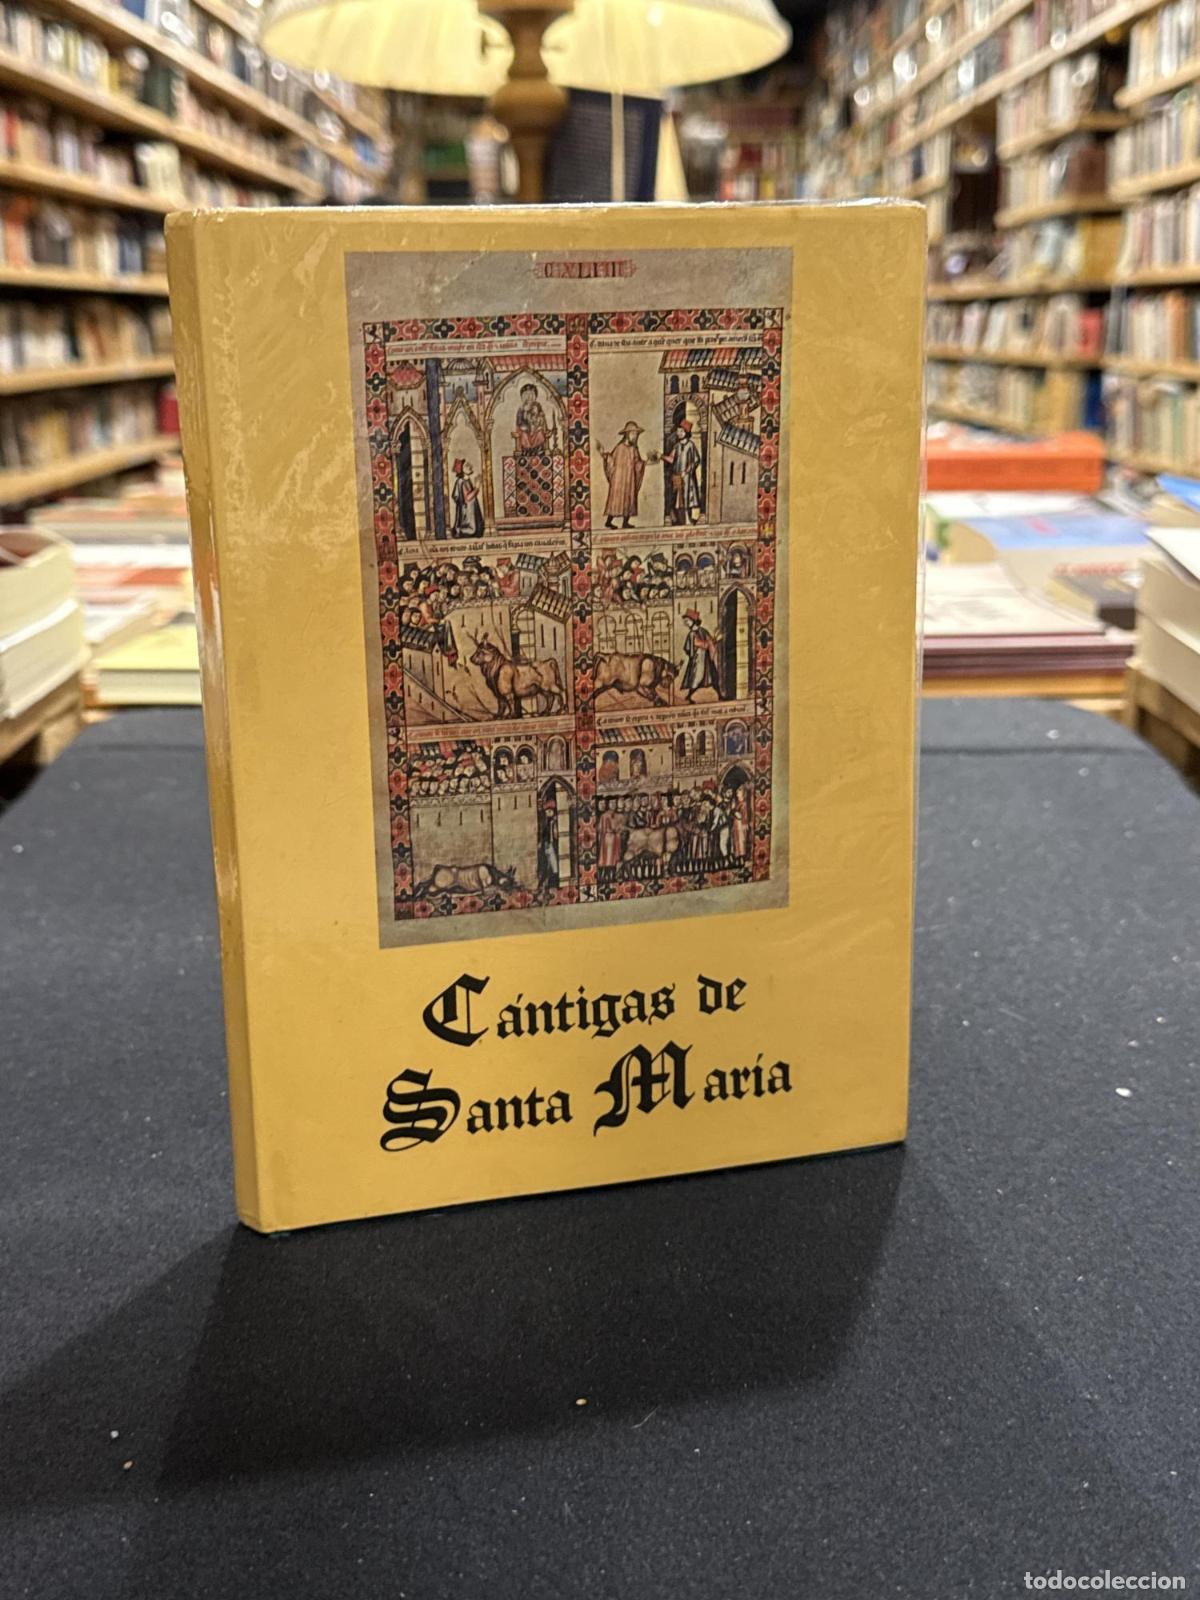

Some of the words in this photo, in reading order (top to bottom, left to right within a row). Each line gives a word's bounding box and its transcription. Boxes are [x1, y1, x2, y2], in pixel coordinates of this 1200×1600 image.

[422, 973, 676, 1047] Cántigas
[698, 973, 748, 1016] de
[379, 1068, 574, 1152] Santa
[593, 1040, 793, 1138] María
